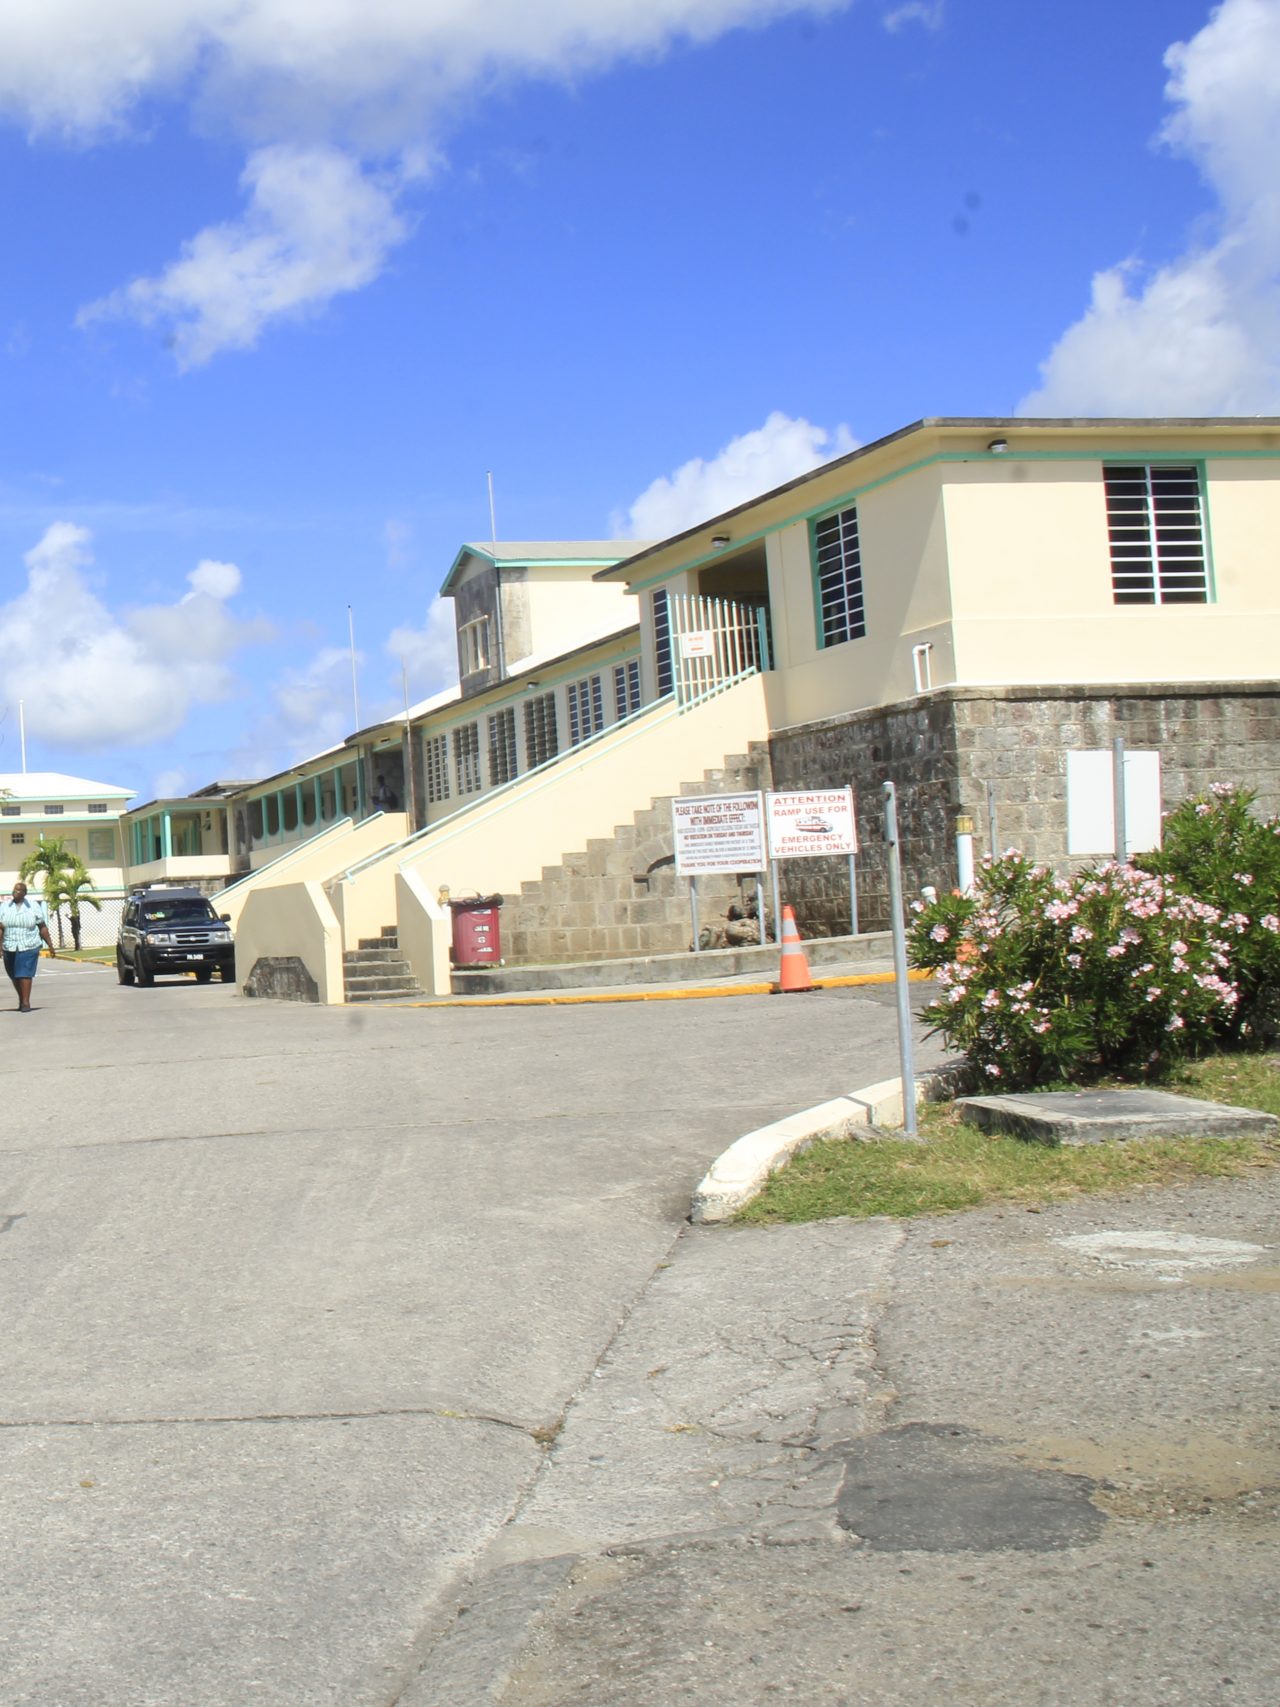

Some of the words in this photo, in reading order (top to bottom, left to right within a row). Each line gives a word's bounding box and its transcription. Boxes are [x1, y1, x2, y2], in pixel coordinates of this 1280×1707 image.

[774, 795, 846, 806] ATTENTION
[774, 808, 802, 816] RAMP
[805, 807, 826, 815] USE
[828, 805, 848, 813] FOR
[781, 833, 844, 844] EMERGENCY
[774, 844, 824, 854] VEHICLES
[826, 842, 852, 851] ONLY
